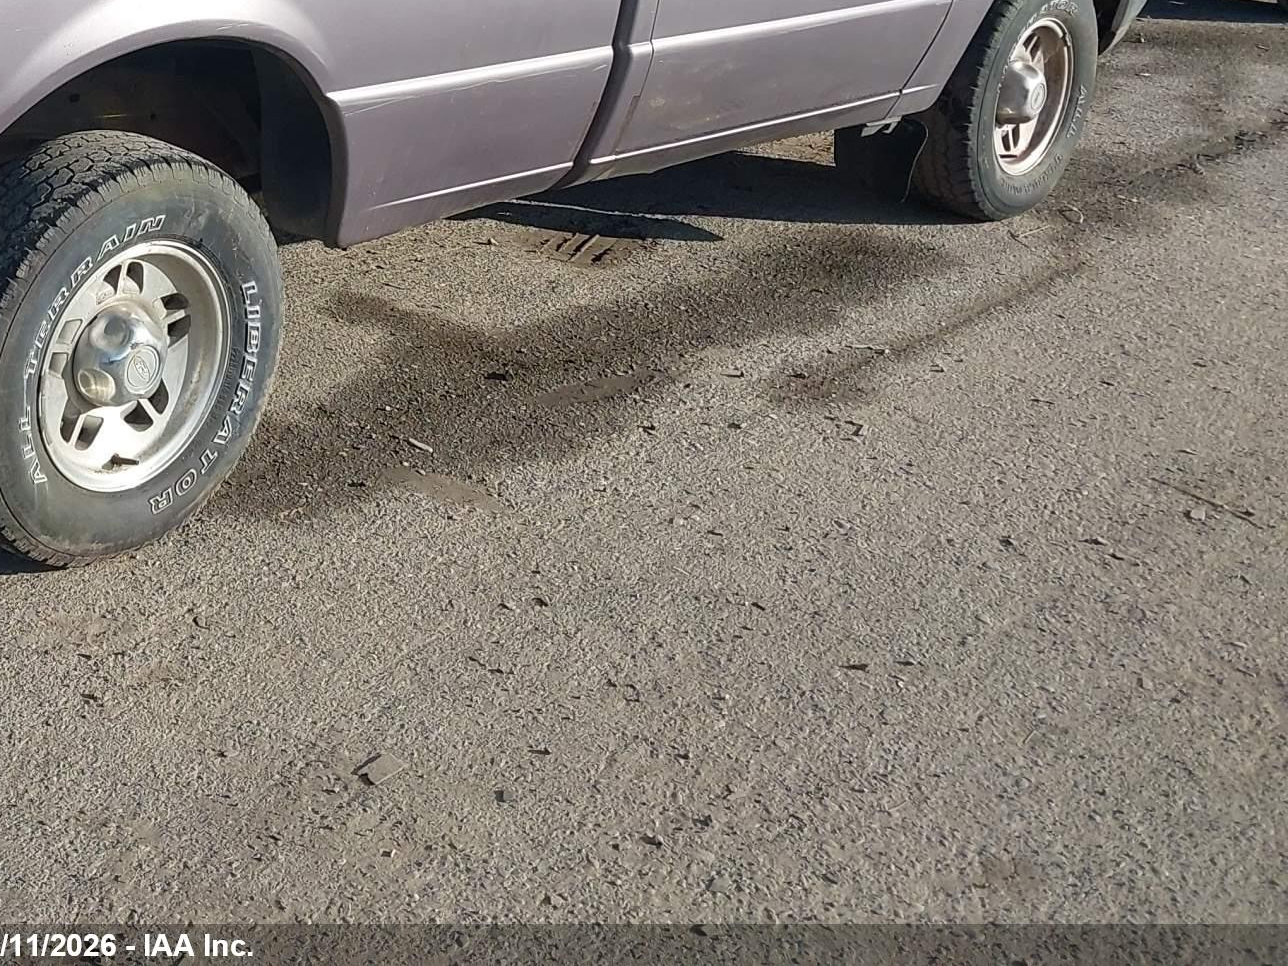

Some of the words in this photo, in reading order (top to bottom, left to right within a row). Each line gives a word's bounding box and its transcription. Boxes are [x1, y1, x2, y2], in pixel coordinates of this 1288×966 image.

[24, 214, 166, 380] TERRAIN
[20, 405, 49, 484] ALL
[149, 280, 262, 515] LIBERATOR
